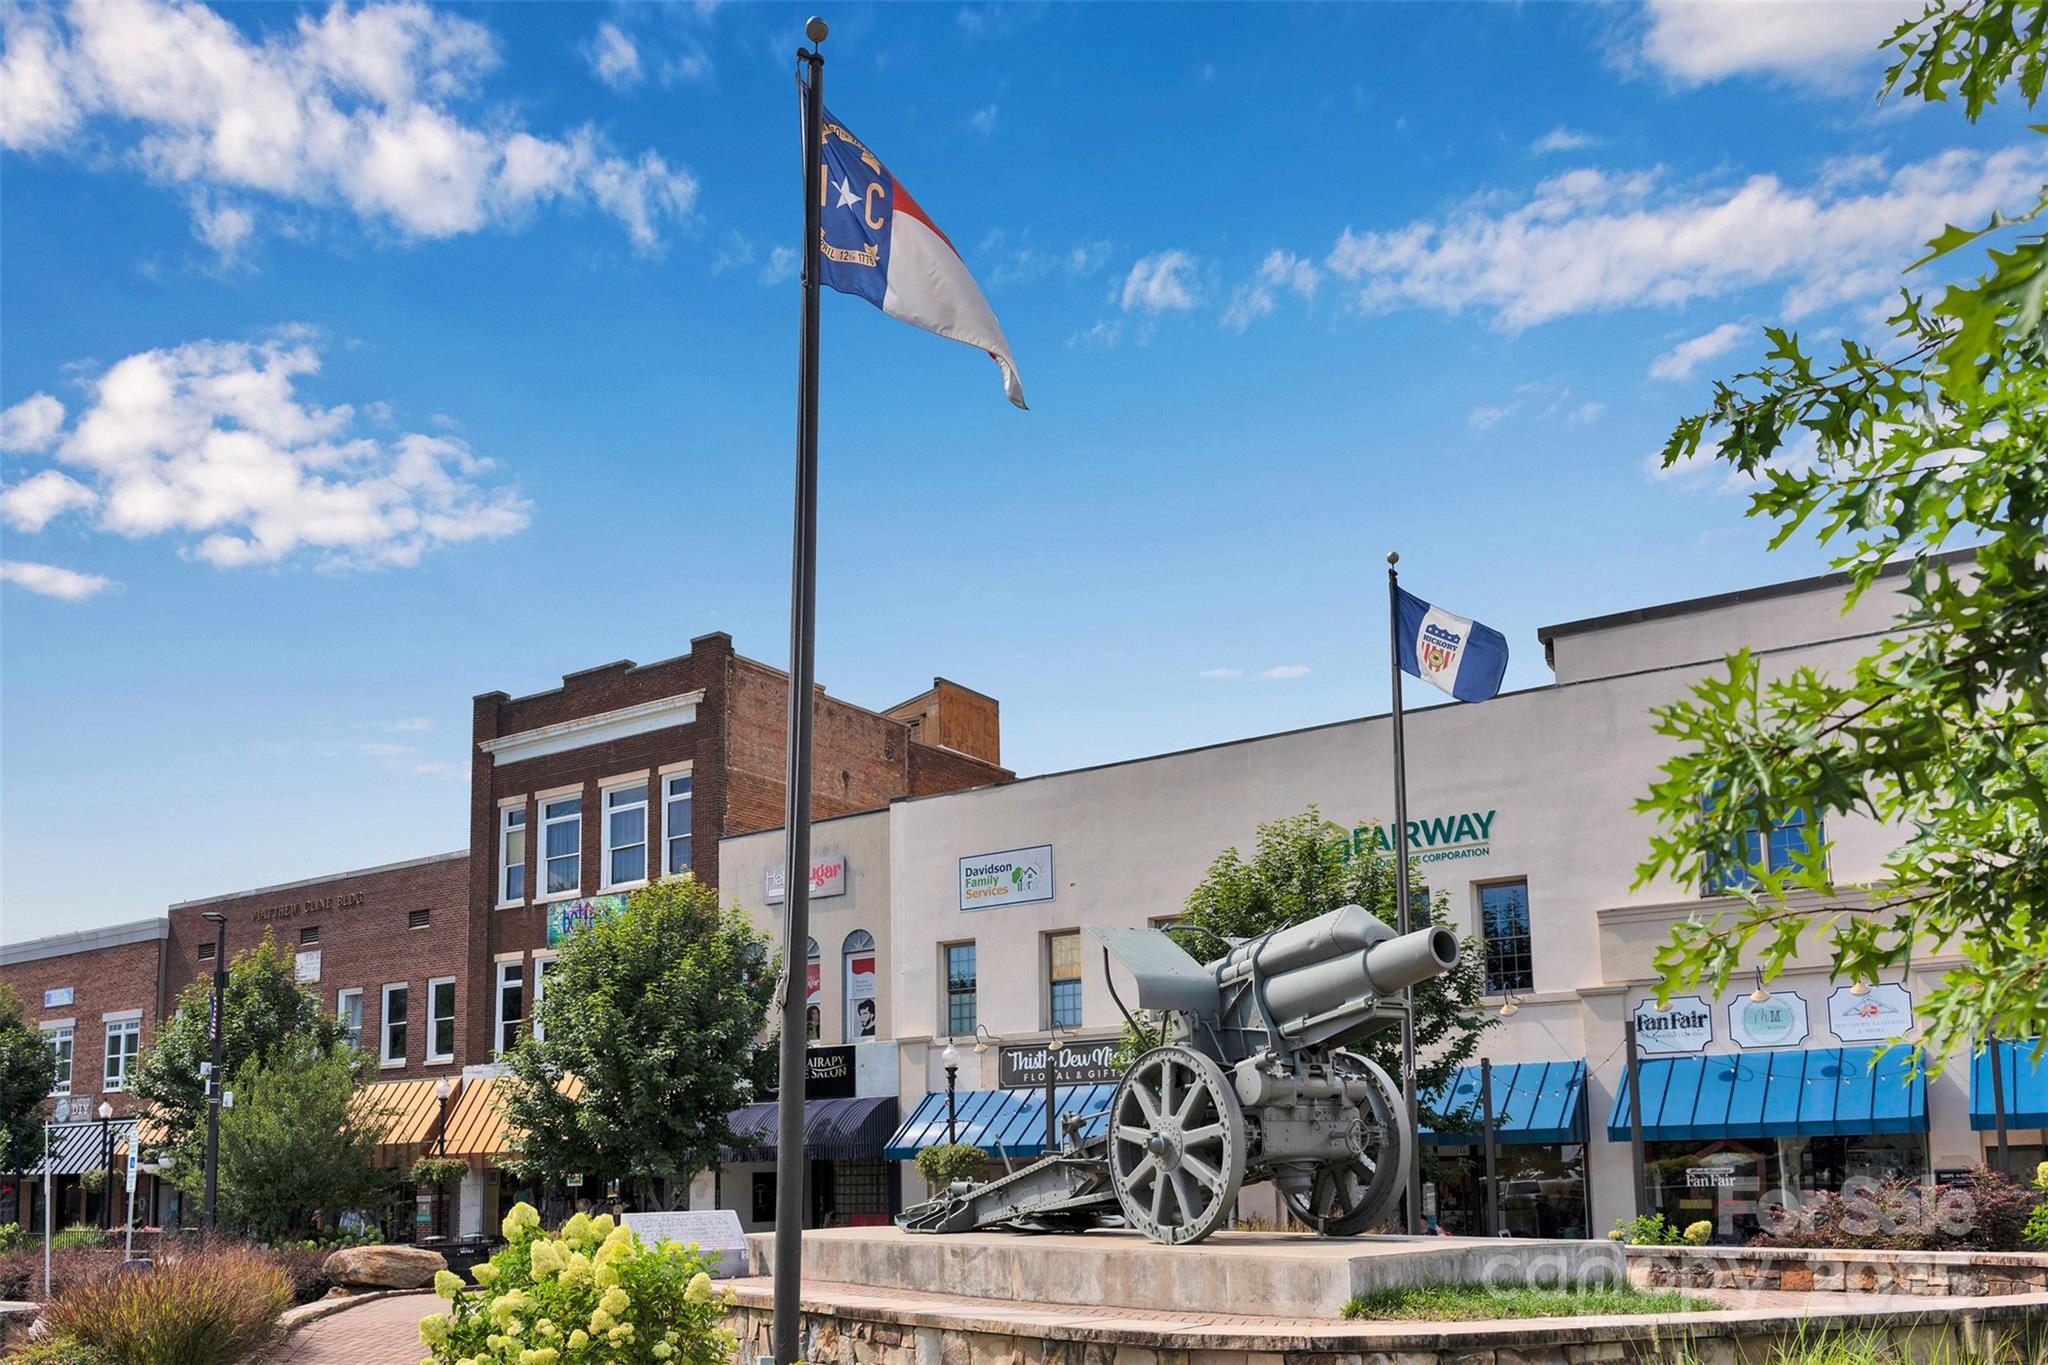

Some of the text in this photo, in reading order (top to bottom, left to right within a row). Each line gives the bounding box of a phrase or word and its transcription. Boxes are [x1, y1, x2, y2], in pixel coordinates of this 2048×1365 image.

[865, 182, 885, 230] C
[1423, 633, 1458, 652] HICKORY
[1422, 847, 1490, 863] CORPORATION
[808, 863, 842, 887] ugar
[965, 863, 1012, 877] Davidson
[966, 874, 999, 889] Family
[966, 886, 1009, 900] Services
[806, 1056, 845, 1068] AIRAPY
[1059, 1048, 1092, 1069] Dew
[811, 1066, 847, 1079] SALON
[1023, 1071, 1071, 1082] FLOAL
[1076, 1071, 1083, 1080] &
[71, 1103, 90, 1115] DIY
